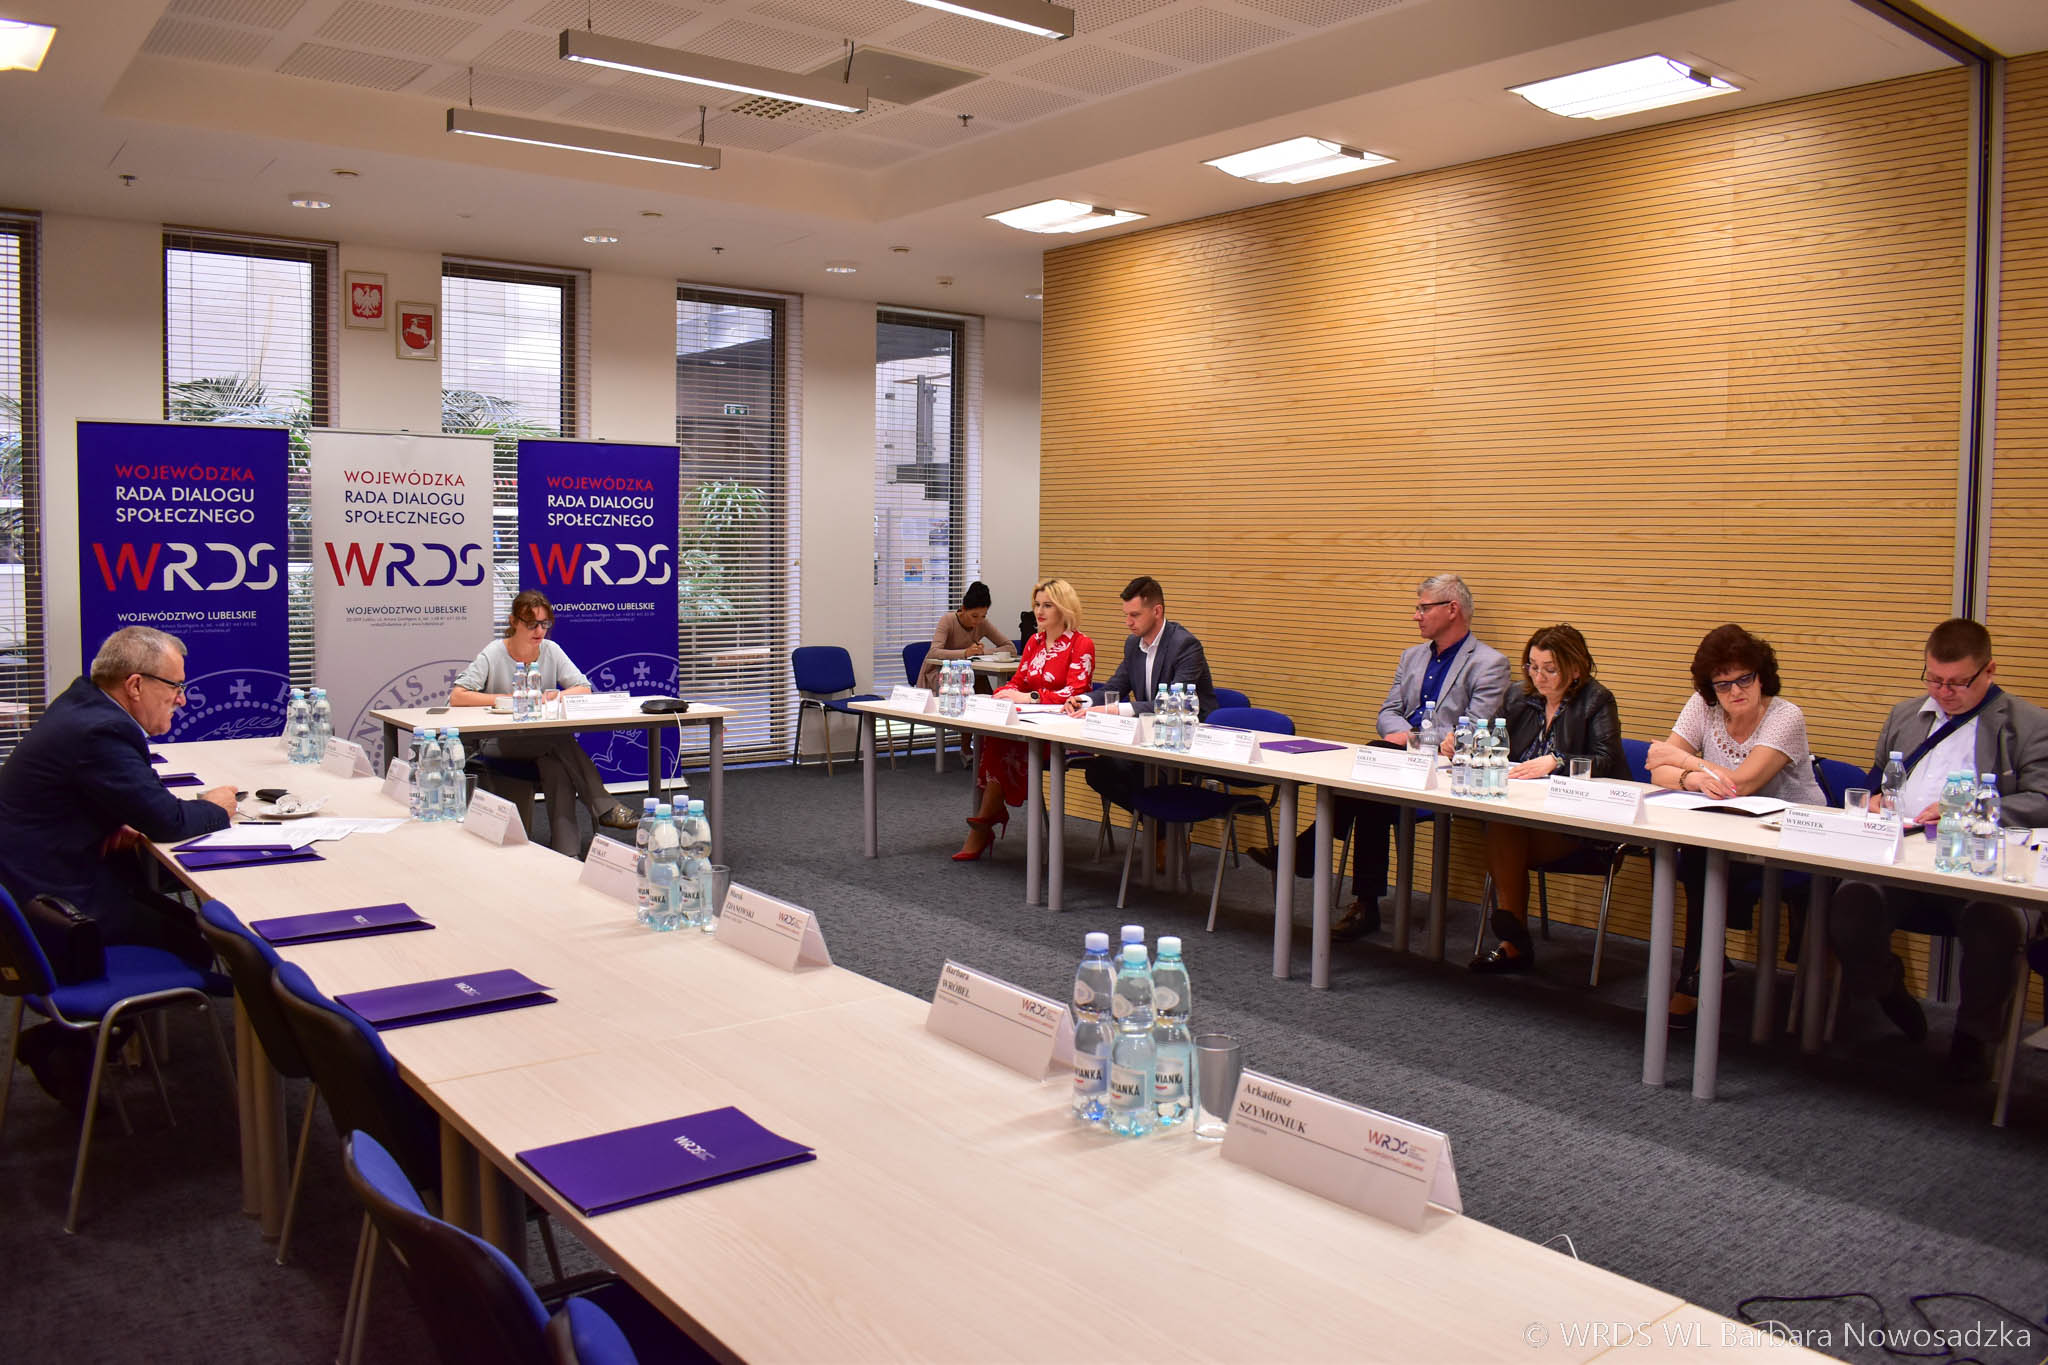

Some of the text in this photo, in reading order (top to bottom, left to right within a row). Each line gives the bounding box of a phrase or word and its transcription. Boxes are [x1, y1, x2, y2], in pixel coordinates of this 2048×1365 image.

[115, 462, 255, 481] WOJEWÓDZKA
[344, 469, 465, 487] WOJEWÓDZKA
[547, 475, 655, 492] WOJEWÓDZKA
[116, 486, 255, 503] RADA DIALOGU
[345, 490, 465, 506] RADA DIALOGU
[547, 494, 654, 510] RADA DIALOGU
[116, 508, 255, 523] SPOŁECZNEGO
[345, 510, 465, 525] SPOŁECZNEGO
[547, 513, 654, 528] SPOŁECZNEGO
[92, 542, 279, 591] WRDS
[324, 542, 485, 587] WRDS
[528, 543, 671, 586] WRDS
[345, 604, 467, 615] WOJEWÓDZTWO LUBELSKIE
[617, 602, 655, 611] LUBELSKIE
[117, 610, 257, 622] WOJEWÓDZTWO LUBELSKIE
[1786, 818, 1824, 830] WYROSTEK
[946, 965, 969, 981] Barbara
[1022, 998, 1048, 1018] WRDS
[1244, 1084, 1292, 1108] Arkadiusz
[1239, 1101, 1308, 1135] SZYMONIUK
[1368, 1128, 1409, 1155] WRDS
